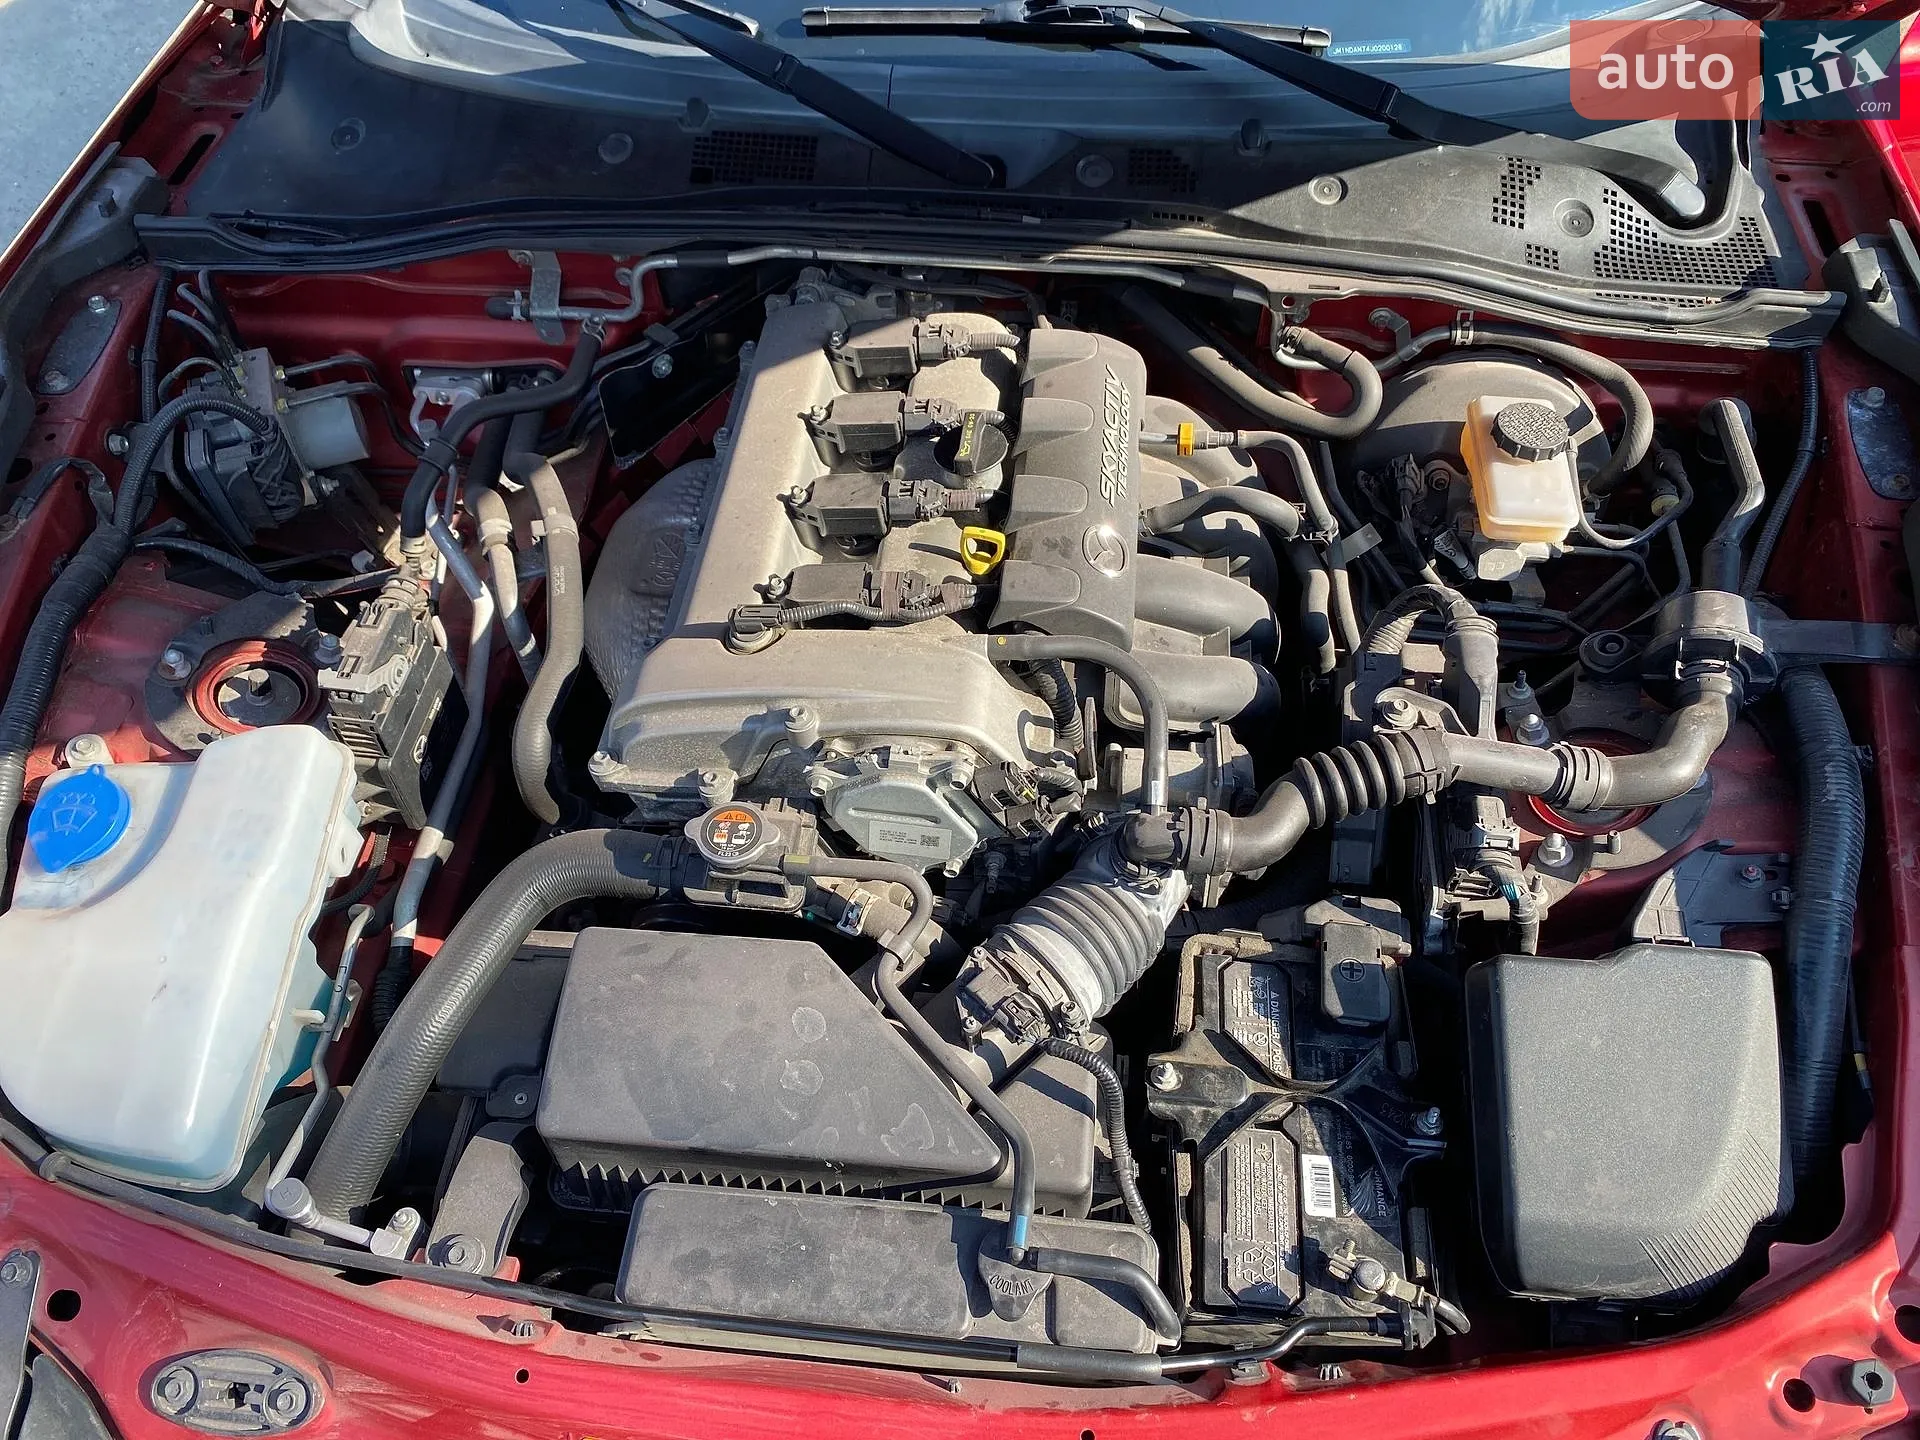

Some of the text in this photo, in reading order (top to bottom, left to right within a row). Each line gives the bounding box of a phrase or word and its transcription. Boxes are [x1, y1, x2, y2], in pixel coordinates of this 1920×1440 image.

[1099, 364, 1119, 508] SKYACTIV
[1116, 380, 1131, 500] TECHNOLOGY
[1271, 1001, 1280, 1039] DANGER
[990, 1274, 1034, 1296] COOLANT
